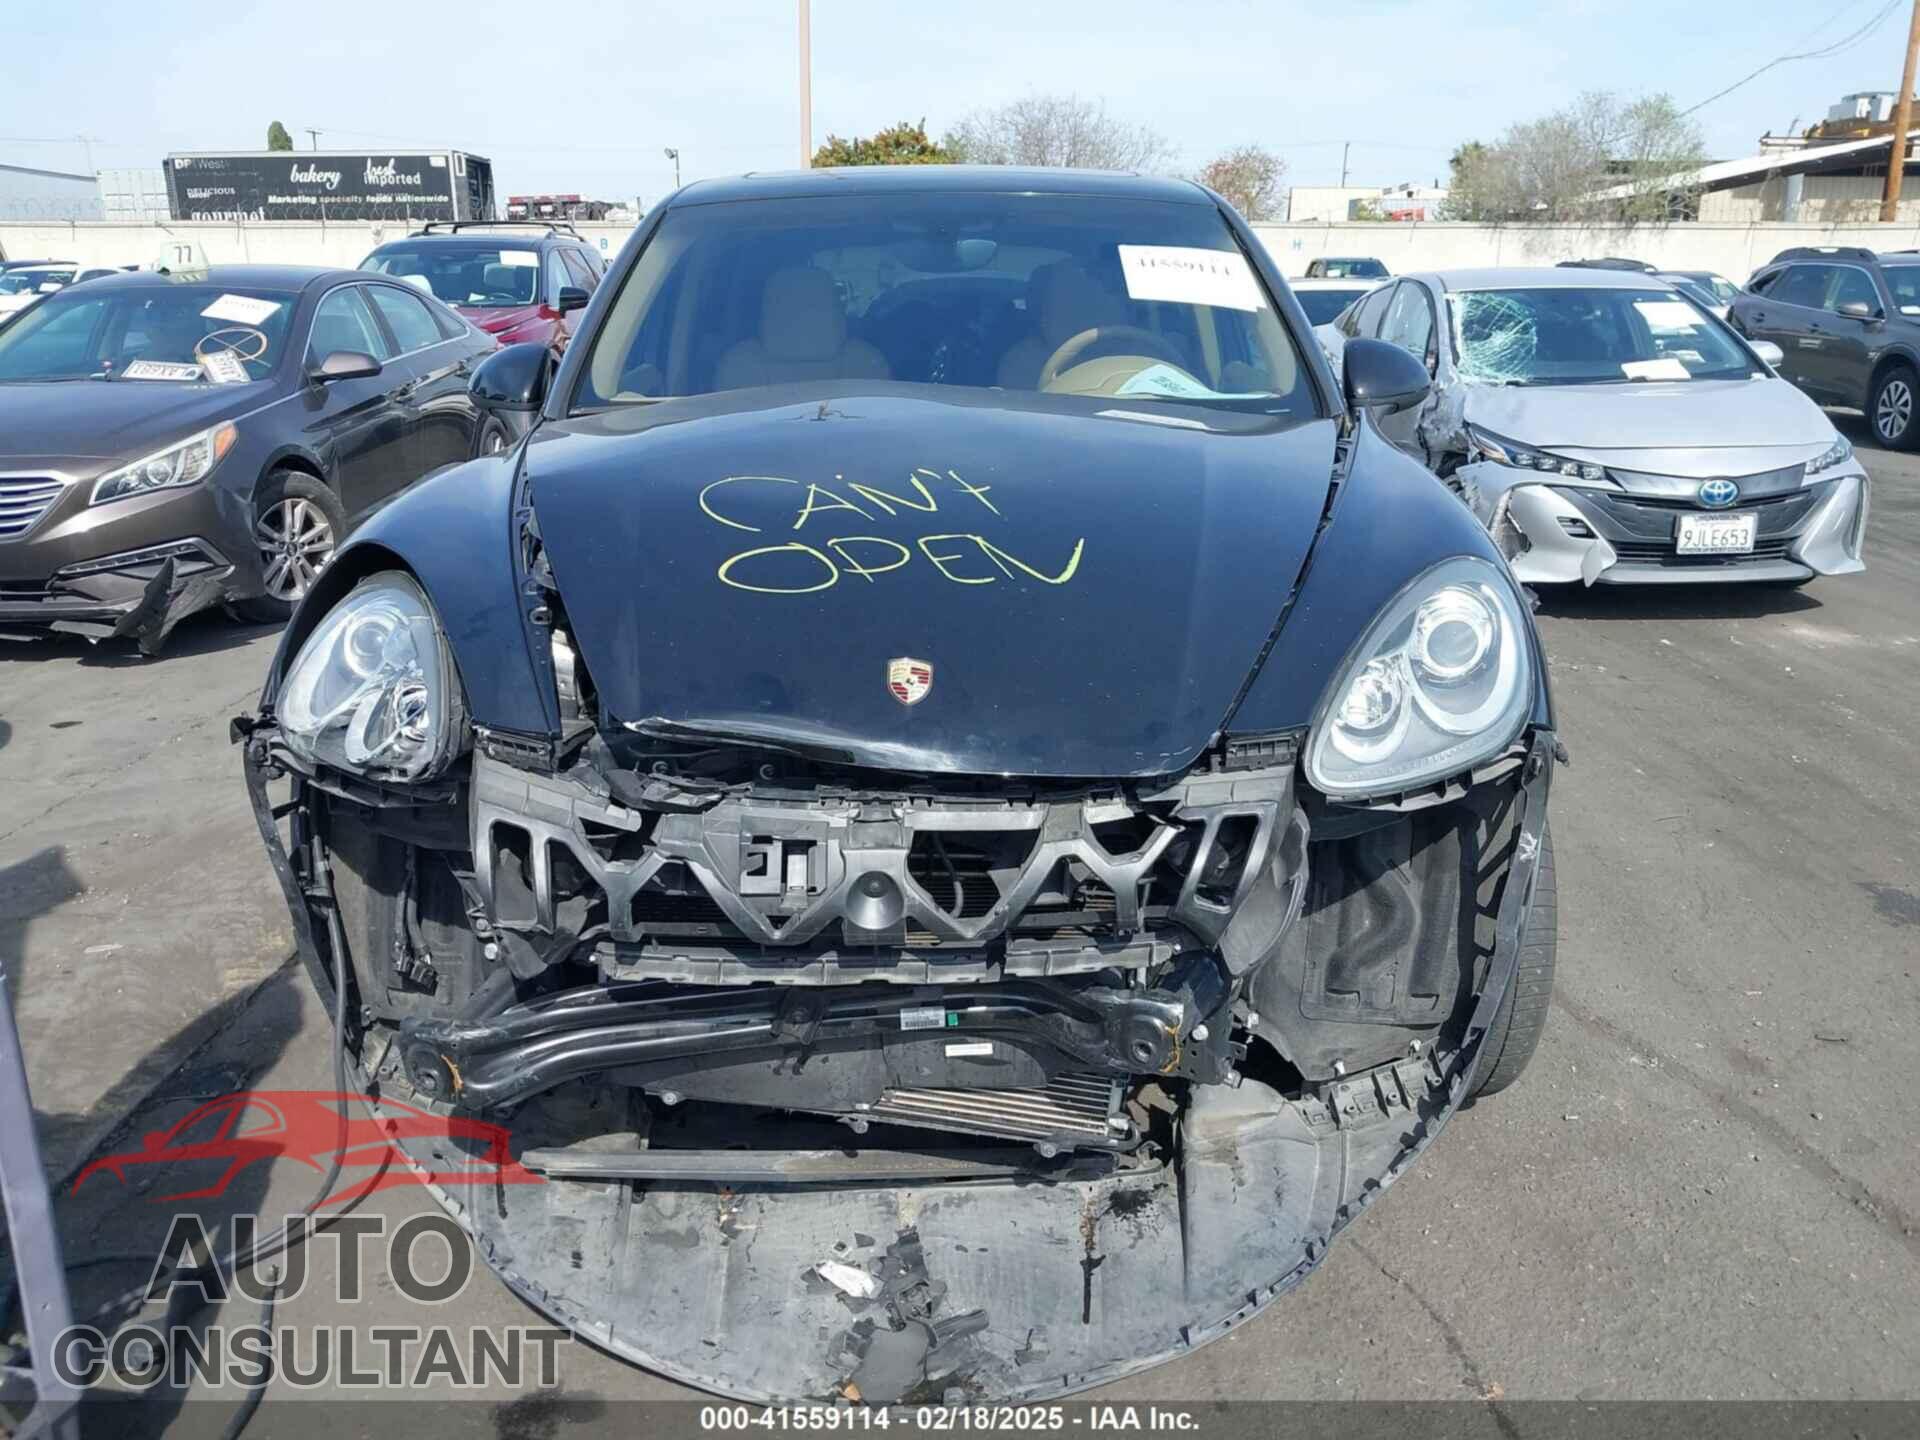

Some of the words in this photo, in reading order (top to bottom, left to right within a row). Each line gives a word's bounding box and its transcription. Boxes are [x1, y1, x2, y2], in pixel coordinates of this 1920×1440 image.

[290, 163, 341, 190] bakery
[364, 172, 421, 187] imported
[268, 195, 317, 204] Marketing
[366, 195, 393, 204] foods
[395, 195, 449, 203] nationwide
[1684, 528, 1749, 547] 9JLE653
[717, 532, 1084, 593] OPEN
